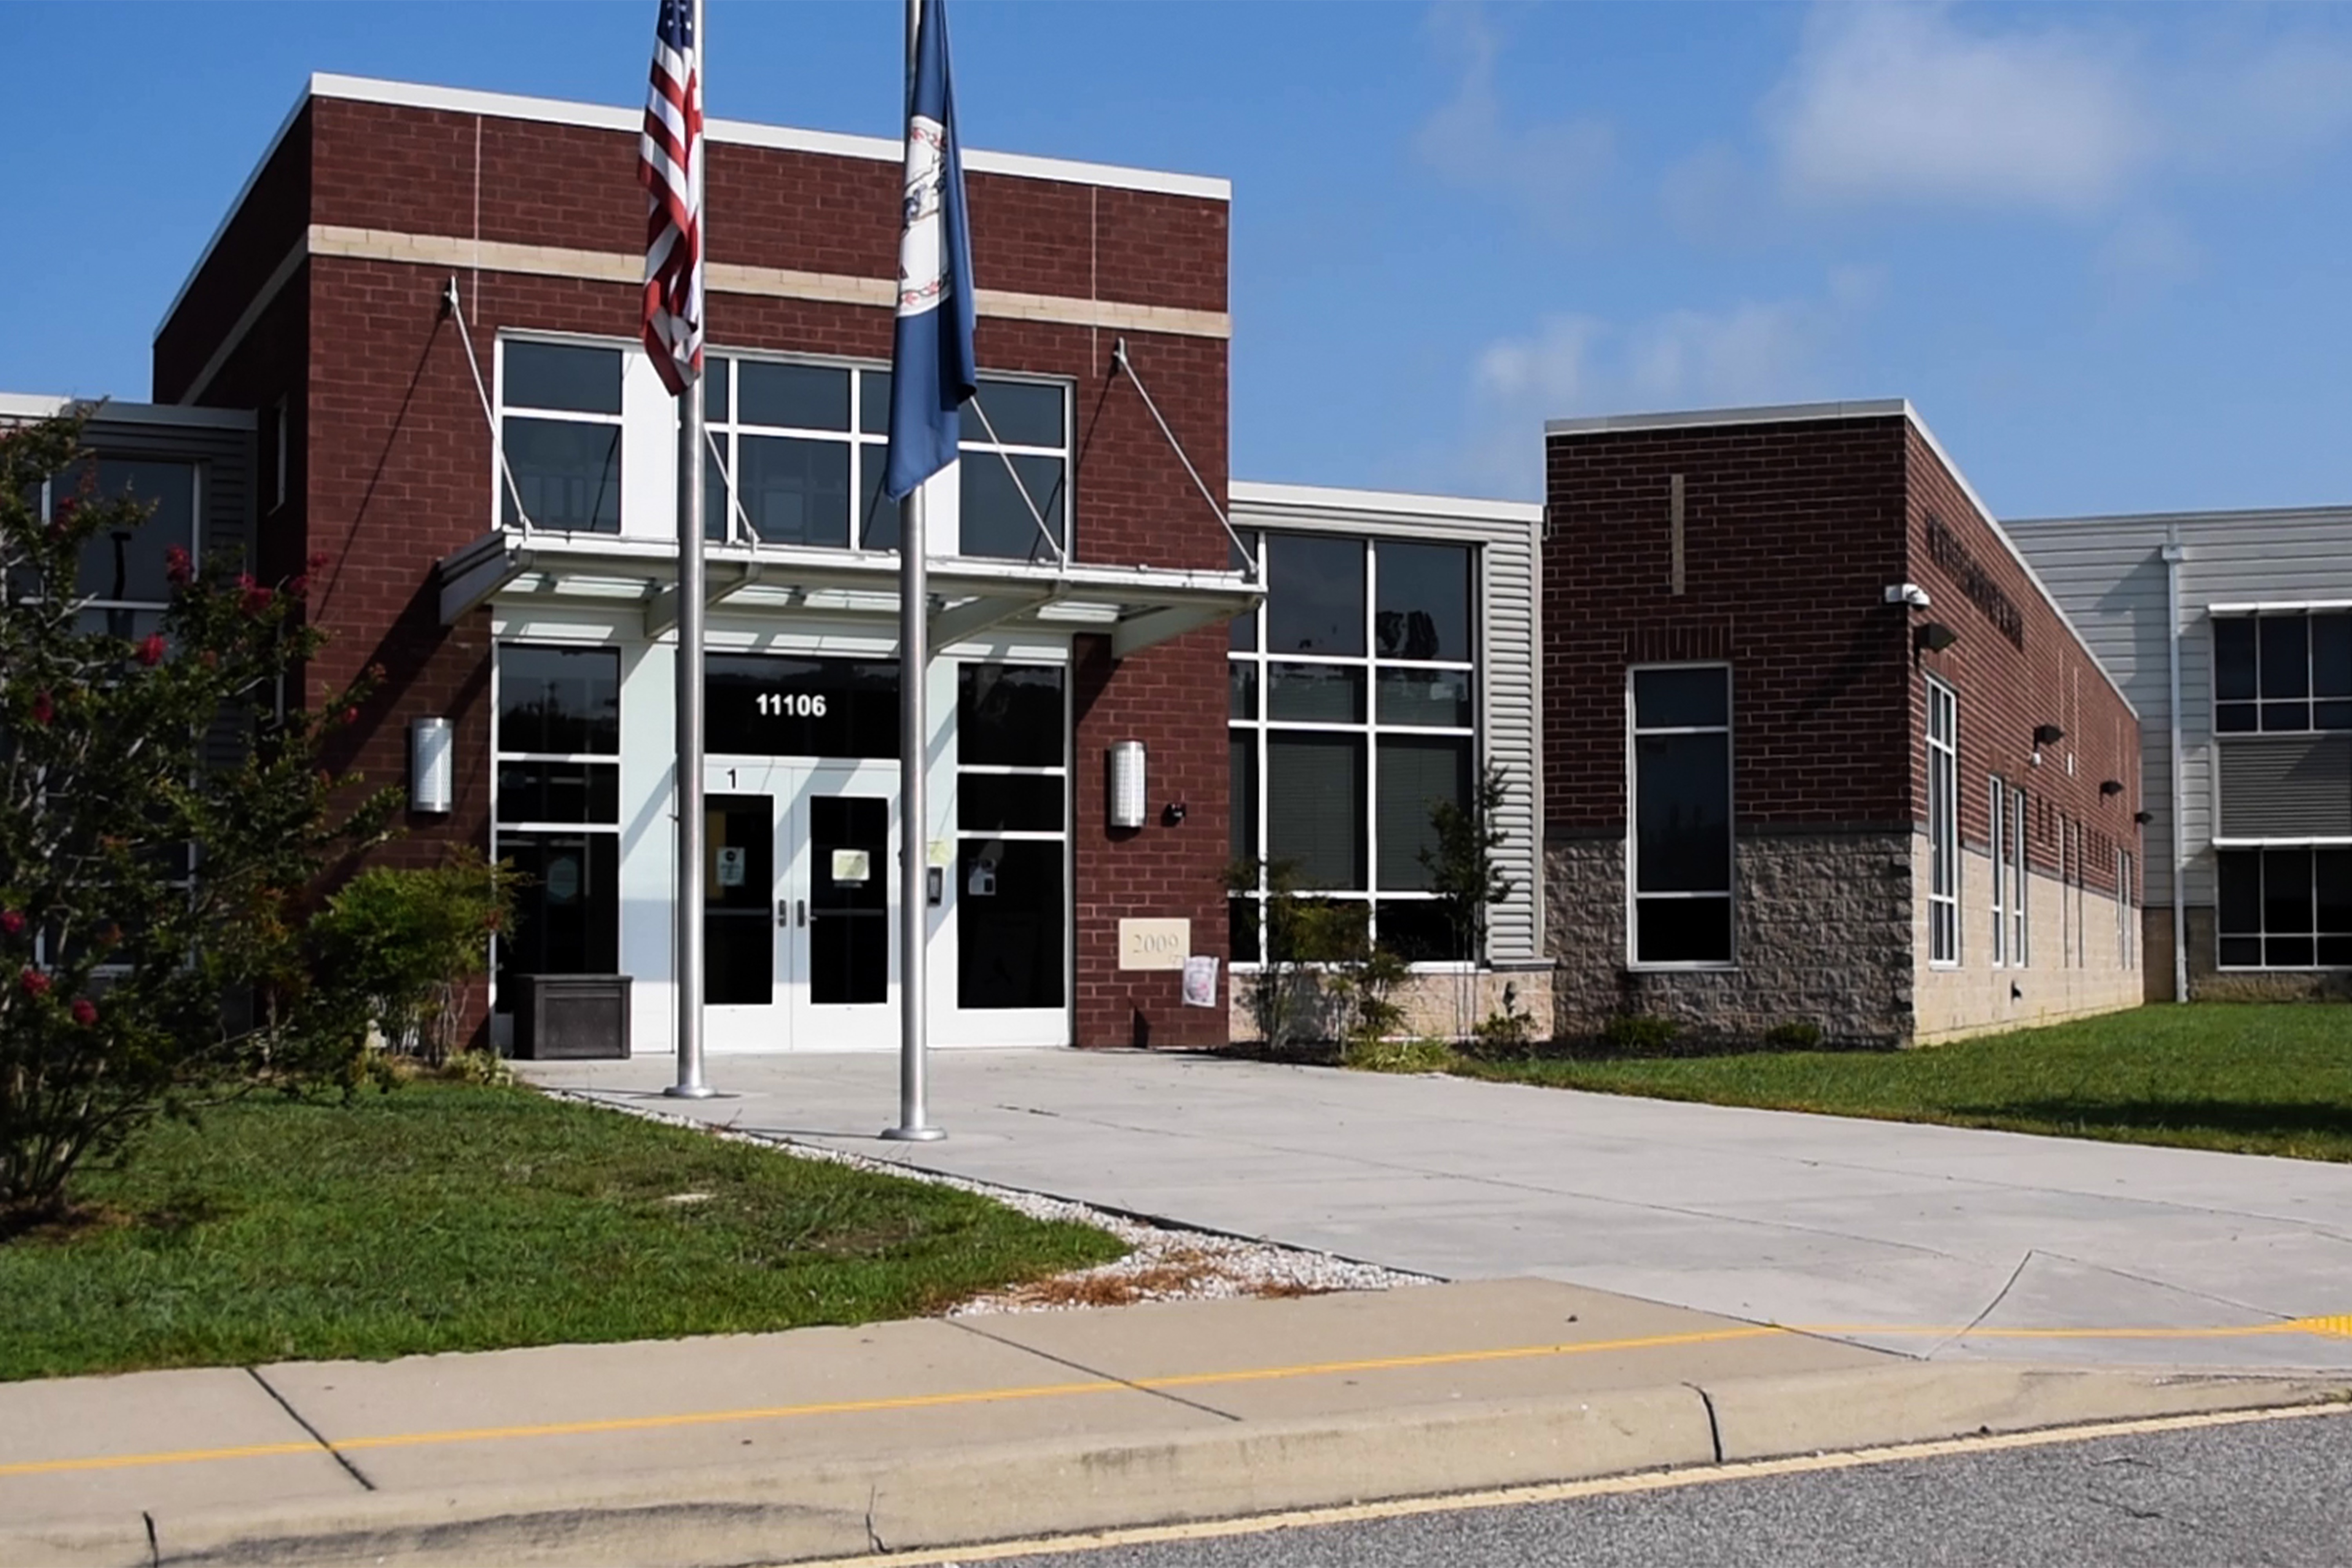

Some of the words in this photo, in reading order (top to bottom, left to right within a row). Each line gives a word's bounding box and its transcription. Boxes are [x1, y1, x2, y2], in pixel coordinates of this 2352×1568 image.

[755, 693, 827, 717] 11106
[727, 768, 737, 789] 1
[1132, 933, 1180, 954] 2009
